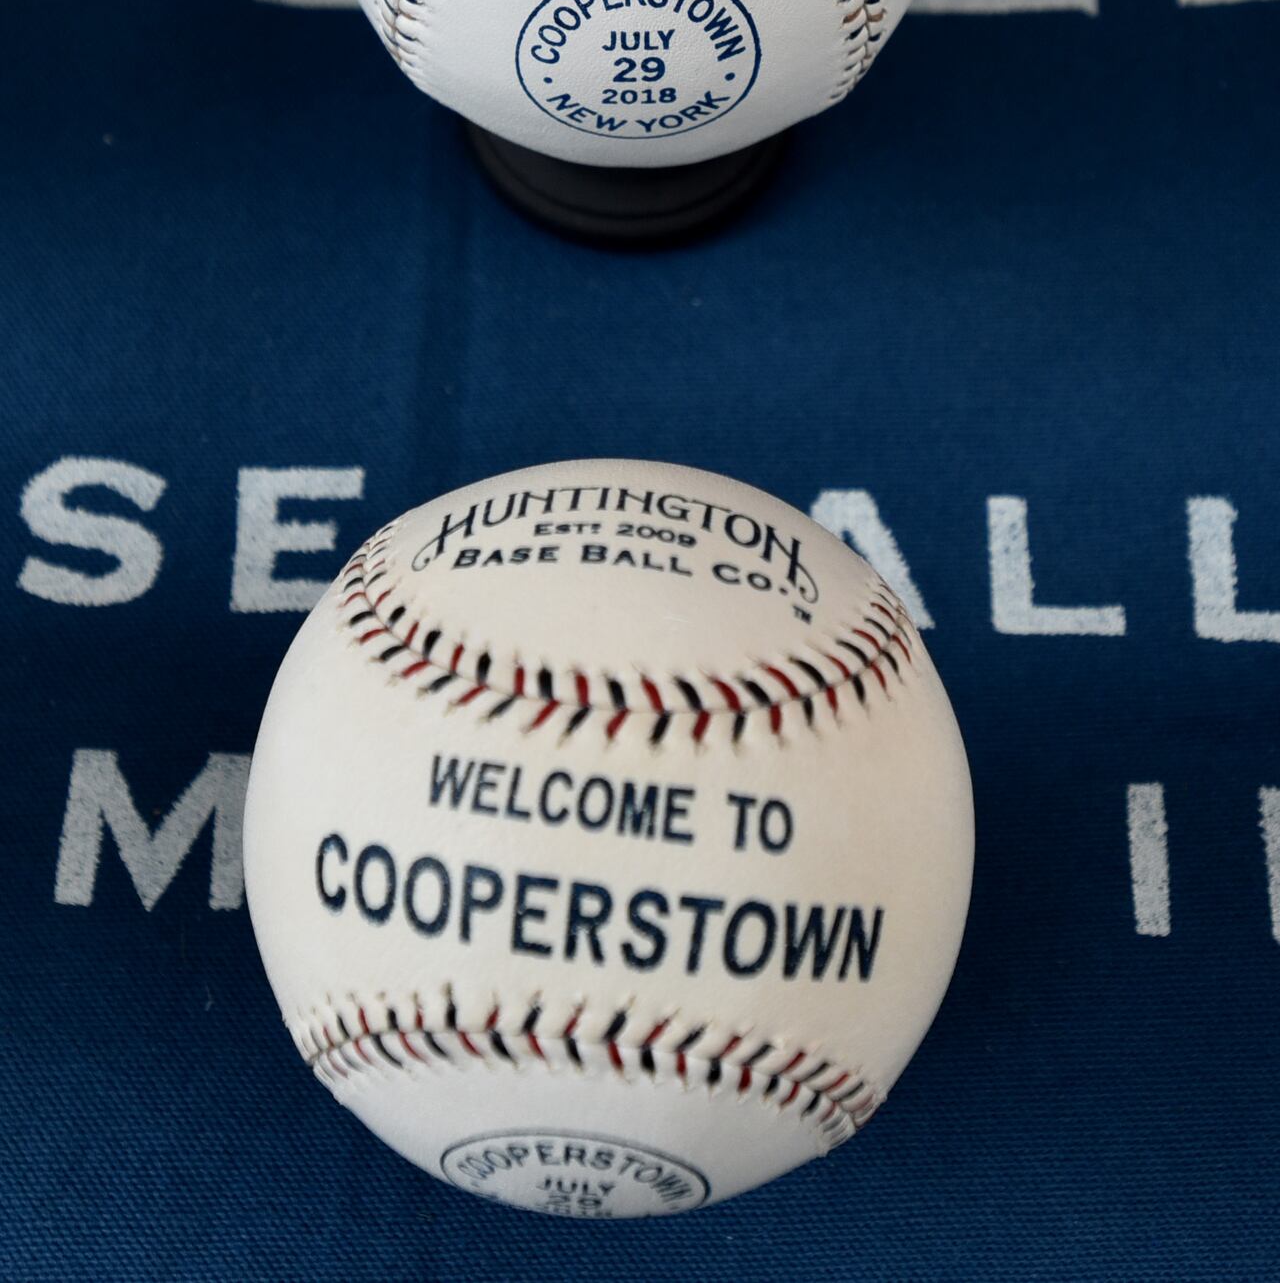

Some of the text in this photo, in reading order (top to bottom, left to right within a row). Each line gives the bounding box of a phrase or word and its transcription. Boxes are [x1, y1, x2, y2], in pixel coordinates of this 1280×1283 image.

[602, 29, 675, 51] JULY
[612, 57, 666, 83] 29
[546, 90, 731, 133] NEW YORK
[601, 87, 677, 105] 2018
[411, 485, 819, 604] HUNTINGTON
[452, 545, 788, 596] BASE BALL CO.
[428, 754, 794, 855] WELCOME TO
[315, 833, 884, 983] COOPERSTOWN
[457, 1142, 692, 1203] COOPERSTOWN
[537, 1175, 615, 1195] JULY
